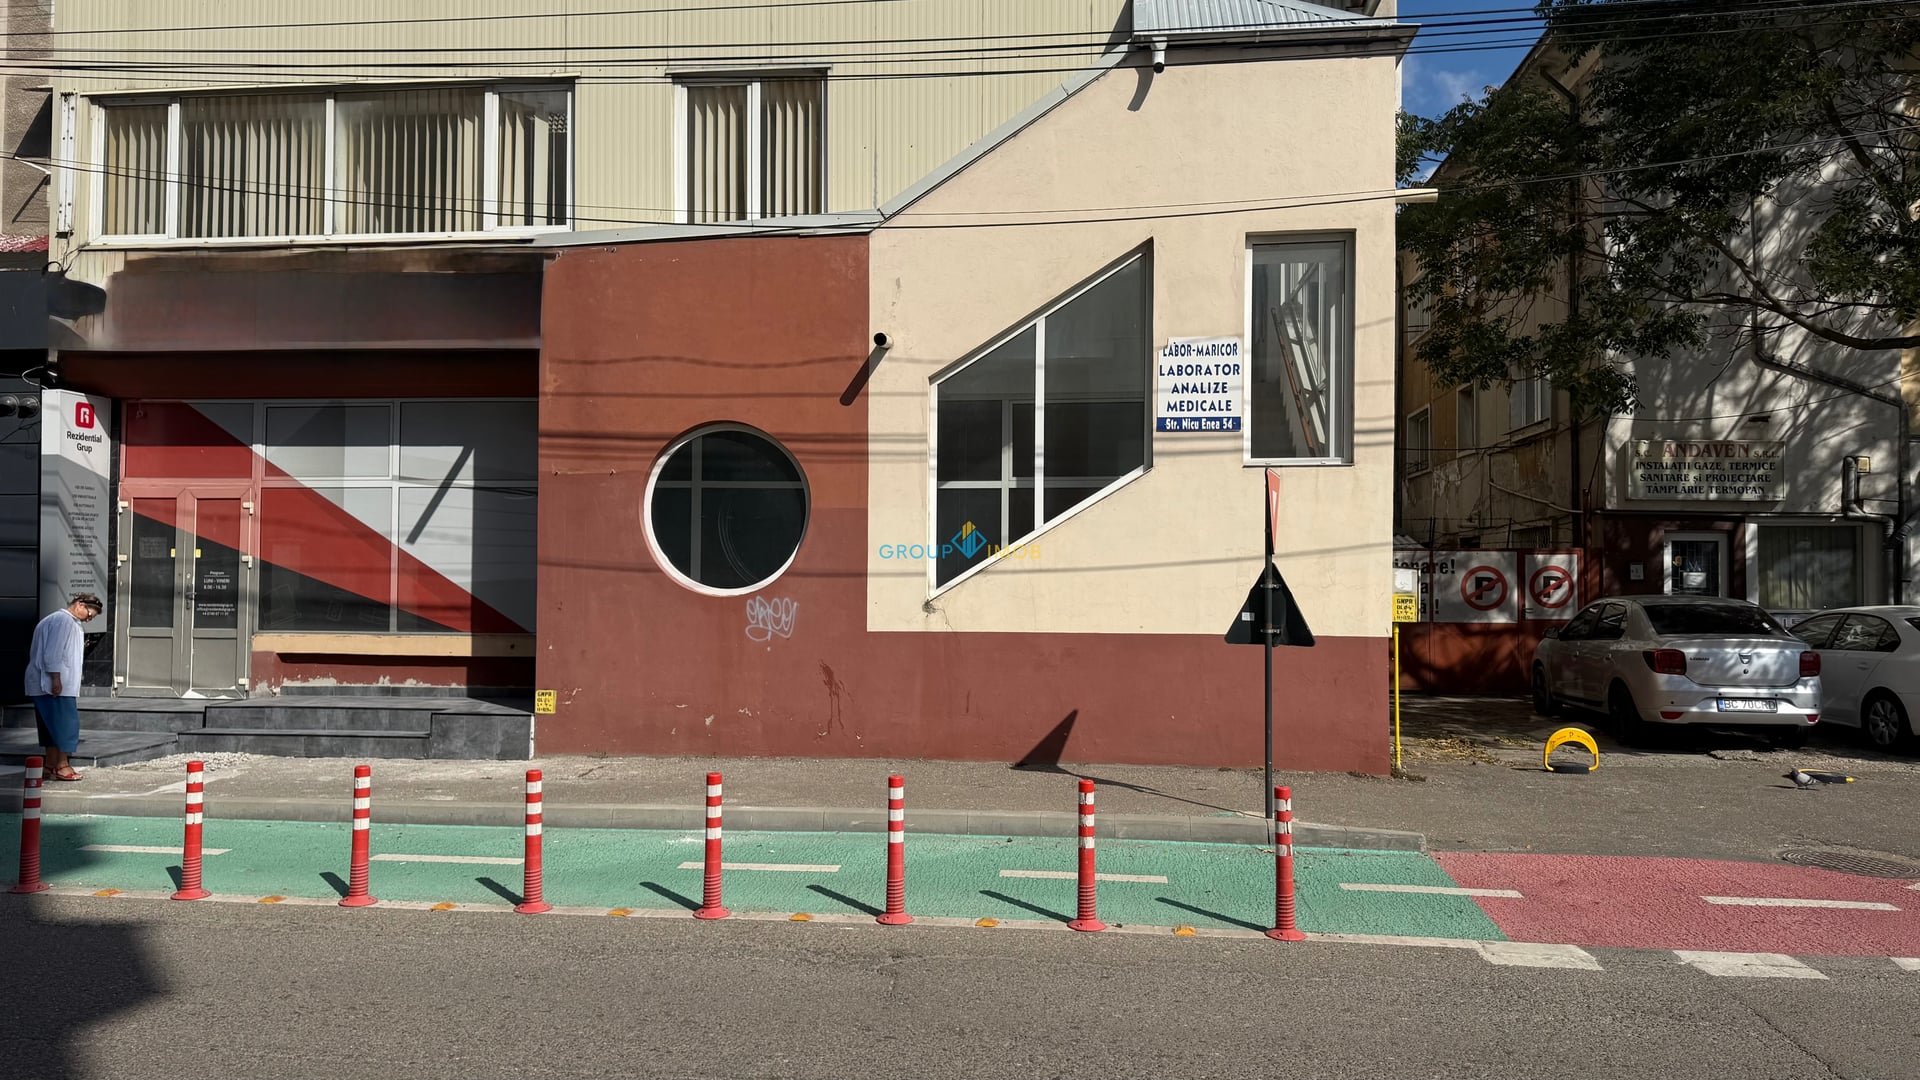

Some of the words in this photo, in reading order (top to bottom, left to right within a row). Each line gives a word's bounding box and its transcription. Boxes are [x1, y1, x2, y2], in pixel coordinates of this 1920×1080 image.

[1163, 343, 1238, 357] LABOR-MARICOR
[1159, 364, 1240, 377] LABORATOR
[1171, 382, 1228, 394] ANALIZE
[1167, 400, 1232, 412] MEDICALE
[1166, 418, 1180, 430] Str.
[1182, 418, 1199, 429] Nicu
[1201, 418, 1220, 429] Enea
[1222, 418, 1233, 429] 54
[66, 431, 103, 443] Rezidential
[77, 443, 93, 454] Grup
[1663, 443, 1750, 458] ANDAVEN
[1694, 462, 1725, 471] GAZE,
[1729, 462, 1776, 471] TERMICE
[1640, 474, 1690, 482] SANITARE
[1705, 474, 1771, 482] PROIECTARE
[1709, 486, 1765, 494] TERMOPAN
[1724, 700, 1739, 709] BC
